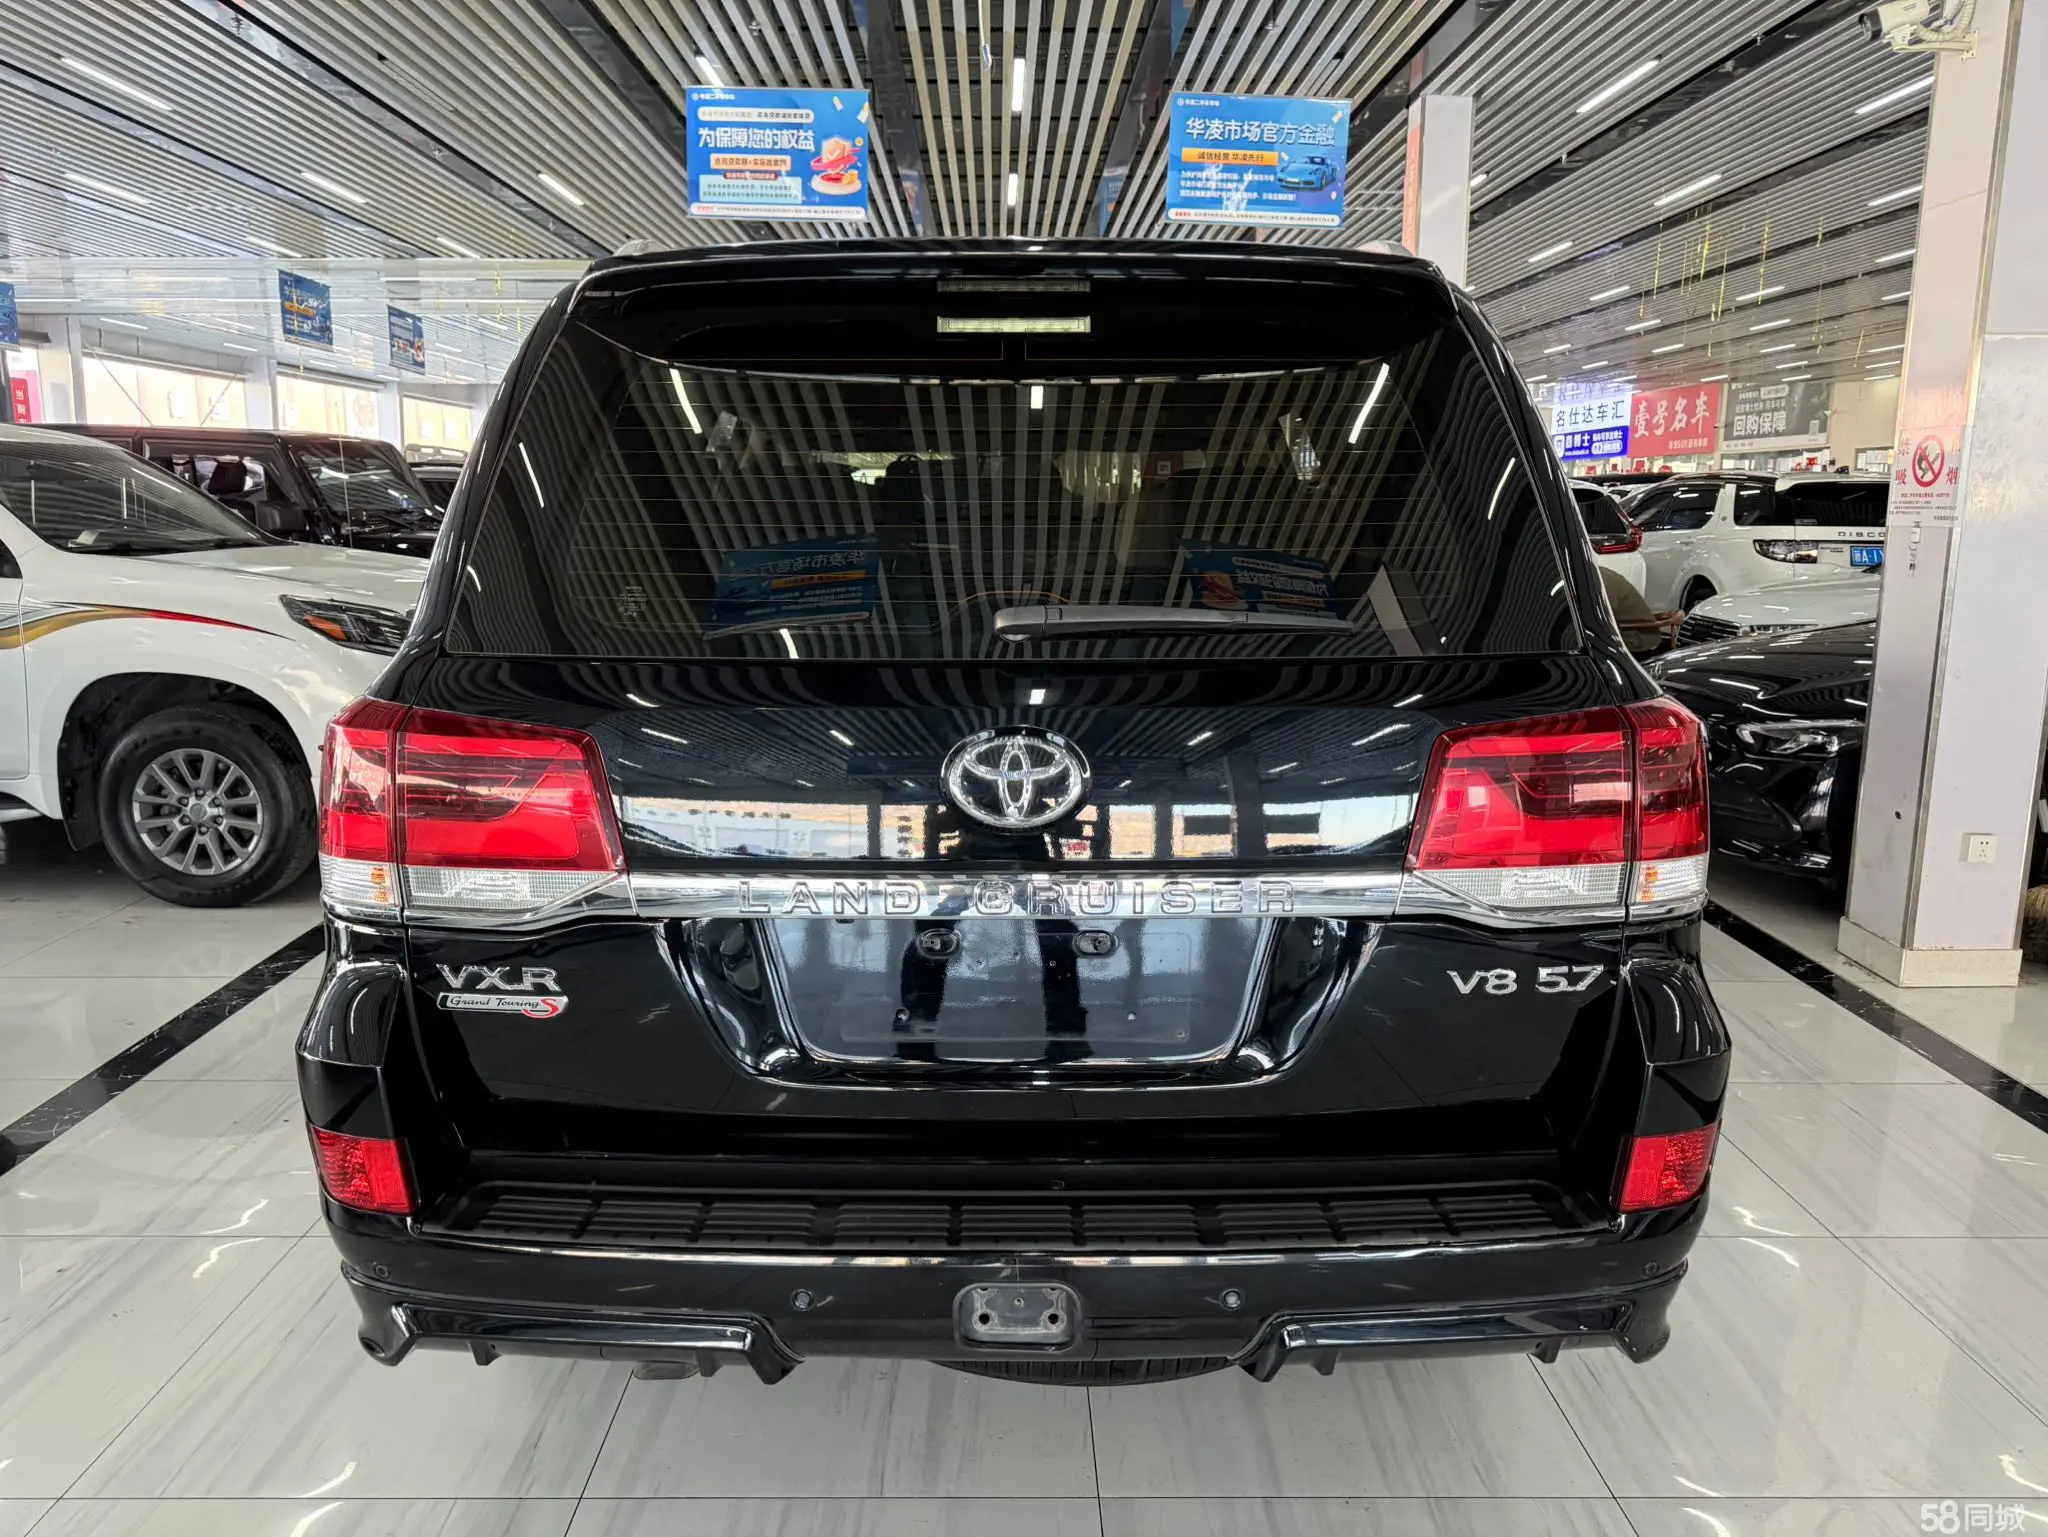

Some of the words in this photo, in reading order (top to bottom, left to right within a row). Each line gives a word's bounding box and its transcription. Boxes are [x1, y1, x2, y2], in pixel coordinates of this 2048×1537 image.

[698, 127, 815, 152] 为保障您的权益
[1186, 117, 1335, 147] 华凌市场官方金融
[1556, 400, 1624, 427] 名仕达车汇
[1634, 391, 1710, 439] 壹号名车
[1733, 410, 1788, 437] 回购保障
[1895, 468, 1907, 485] 吸
[1946, 467, 1959, 485] 烟
[737, 880, 919, 914] LAND
[973, 880, 1295, 915] CRUISER
[1446, 968, 1518, 995] V8
[450, 996, 490, 1006] Grand
[496, 997, 539, 1009] Touring
